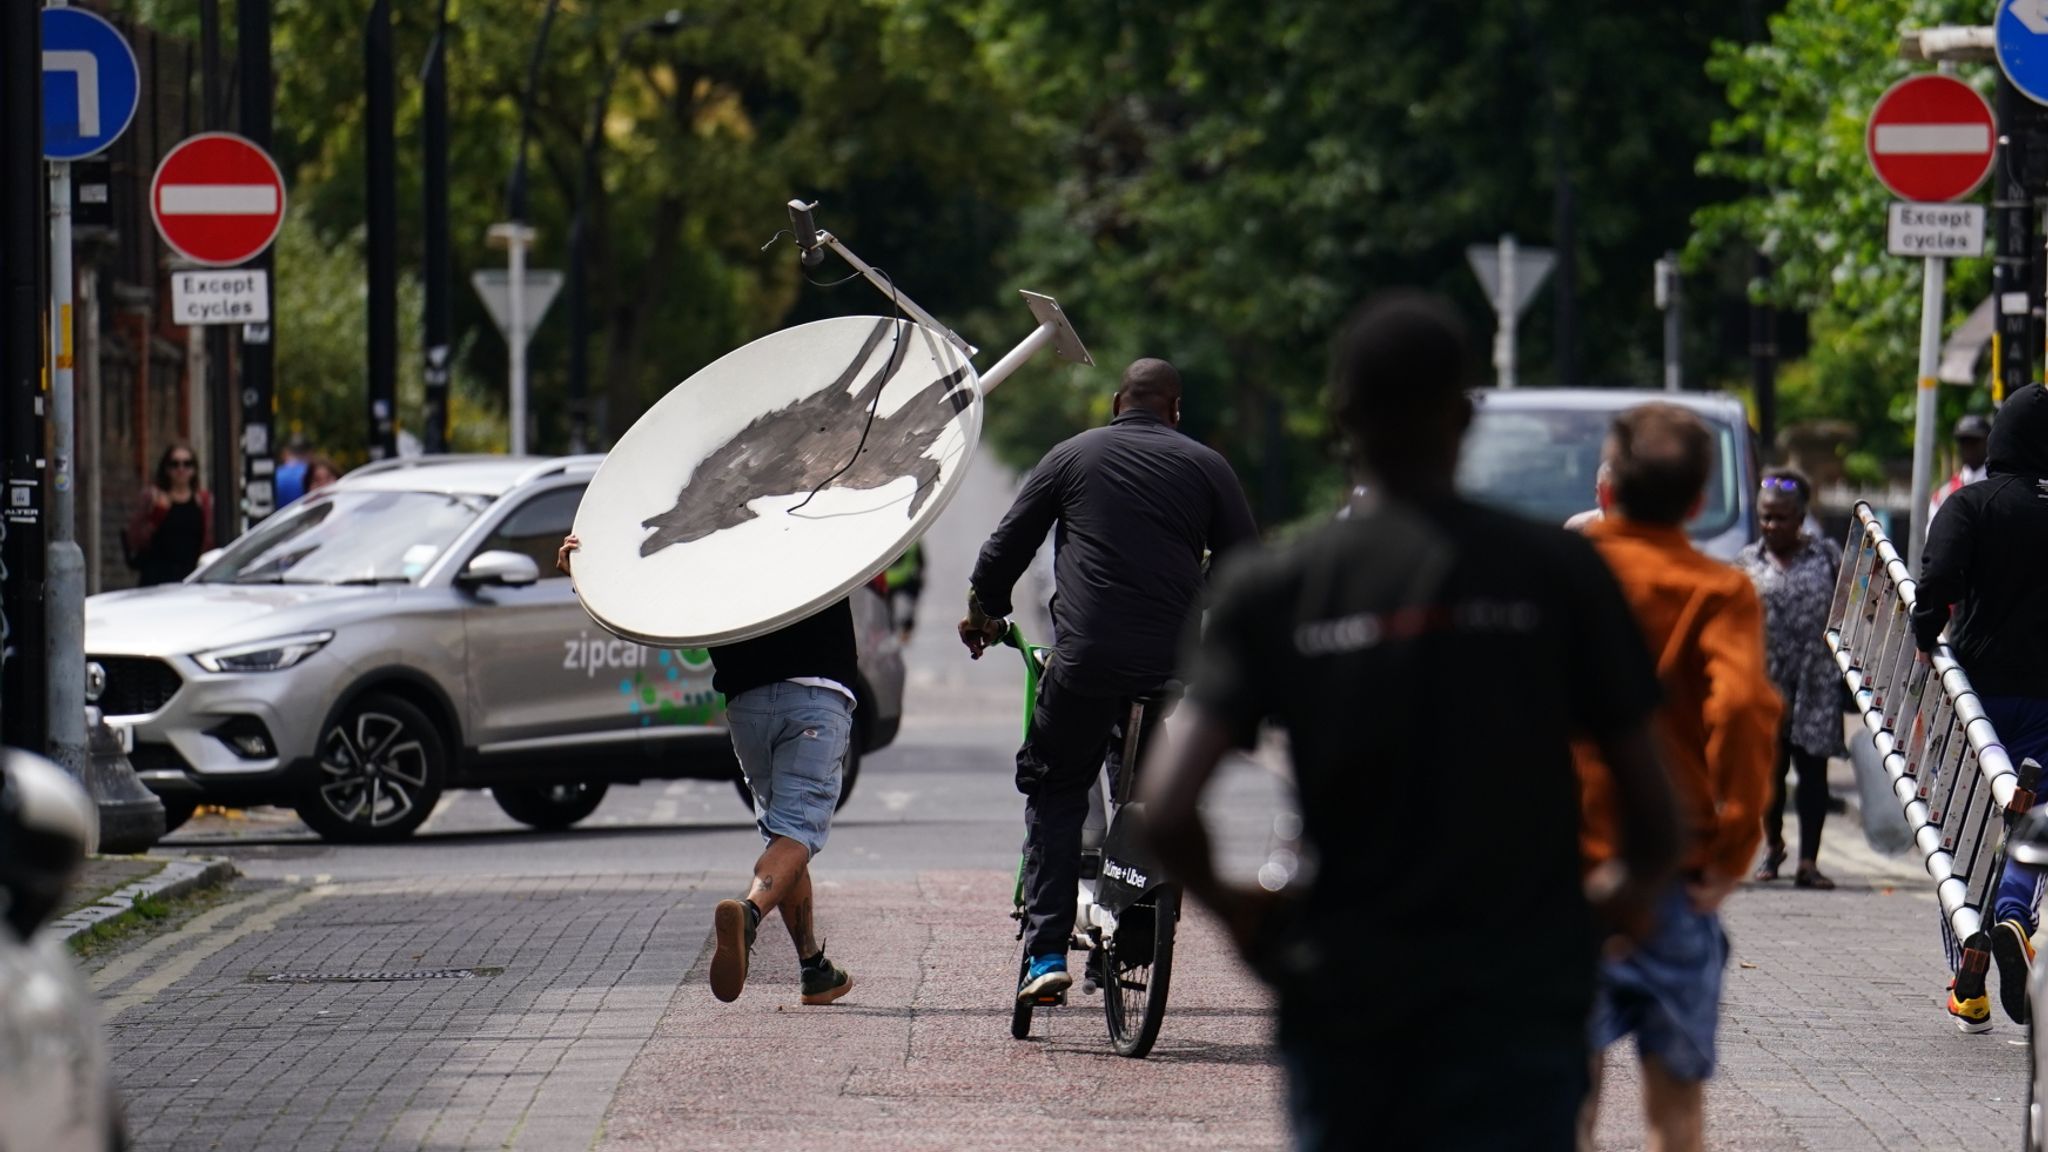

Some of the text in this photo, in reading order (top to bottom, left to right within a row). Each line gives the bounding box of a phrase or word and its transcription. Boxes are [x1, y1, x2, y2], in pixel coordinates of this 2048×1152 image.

[1901, 207, 1971, 227] Except
[1903, 232, 1967, 249] cycles
[183, 276, 254, 295] Except
[188, 299, 252, 318] cycles
[4, 508, 39, 516] ALTER
[1126, 867, 1147, 889] Uber
